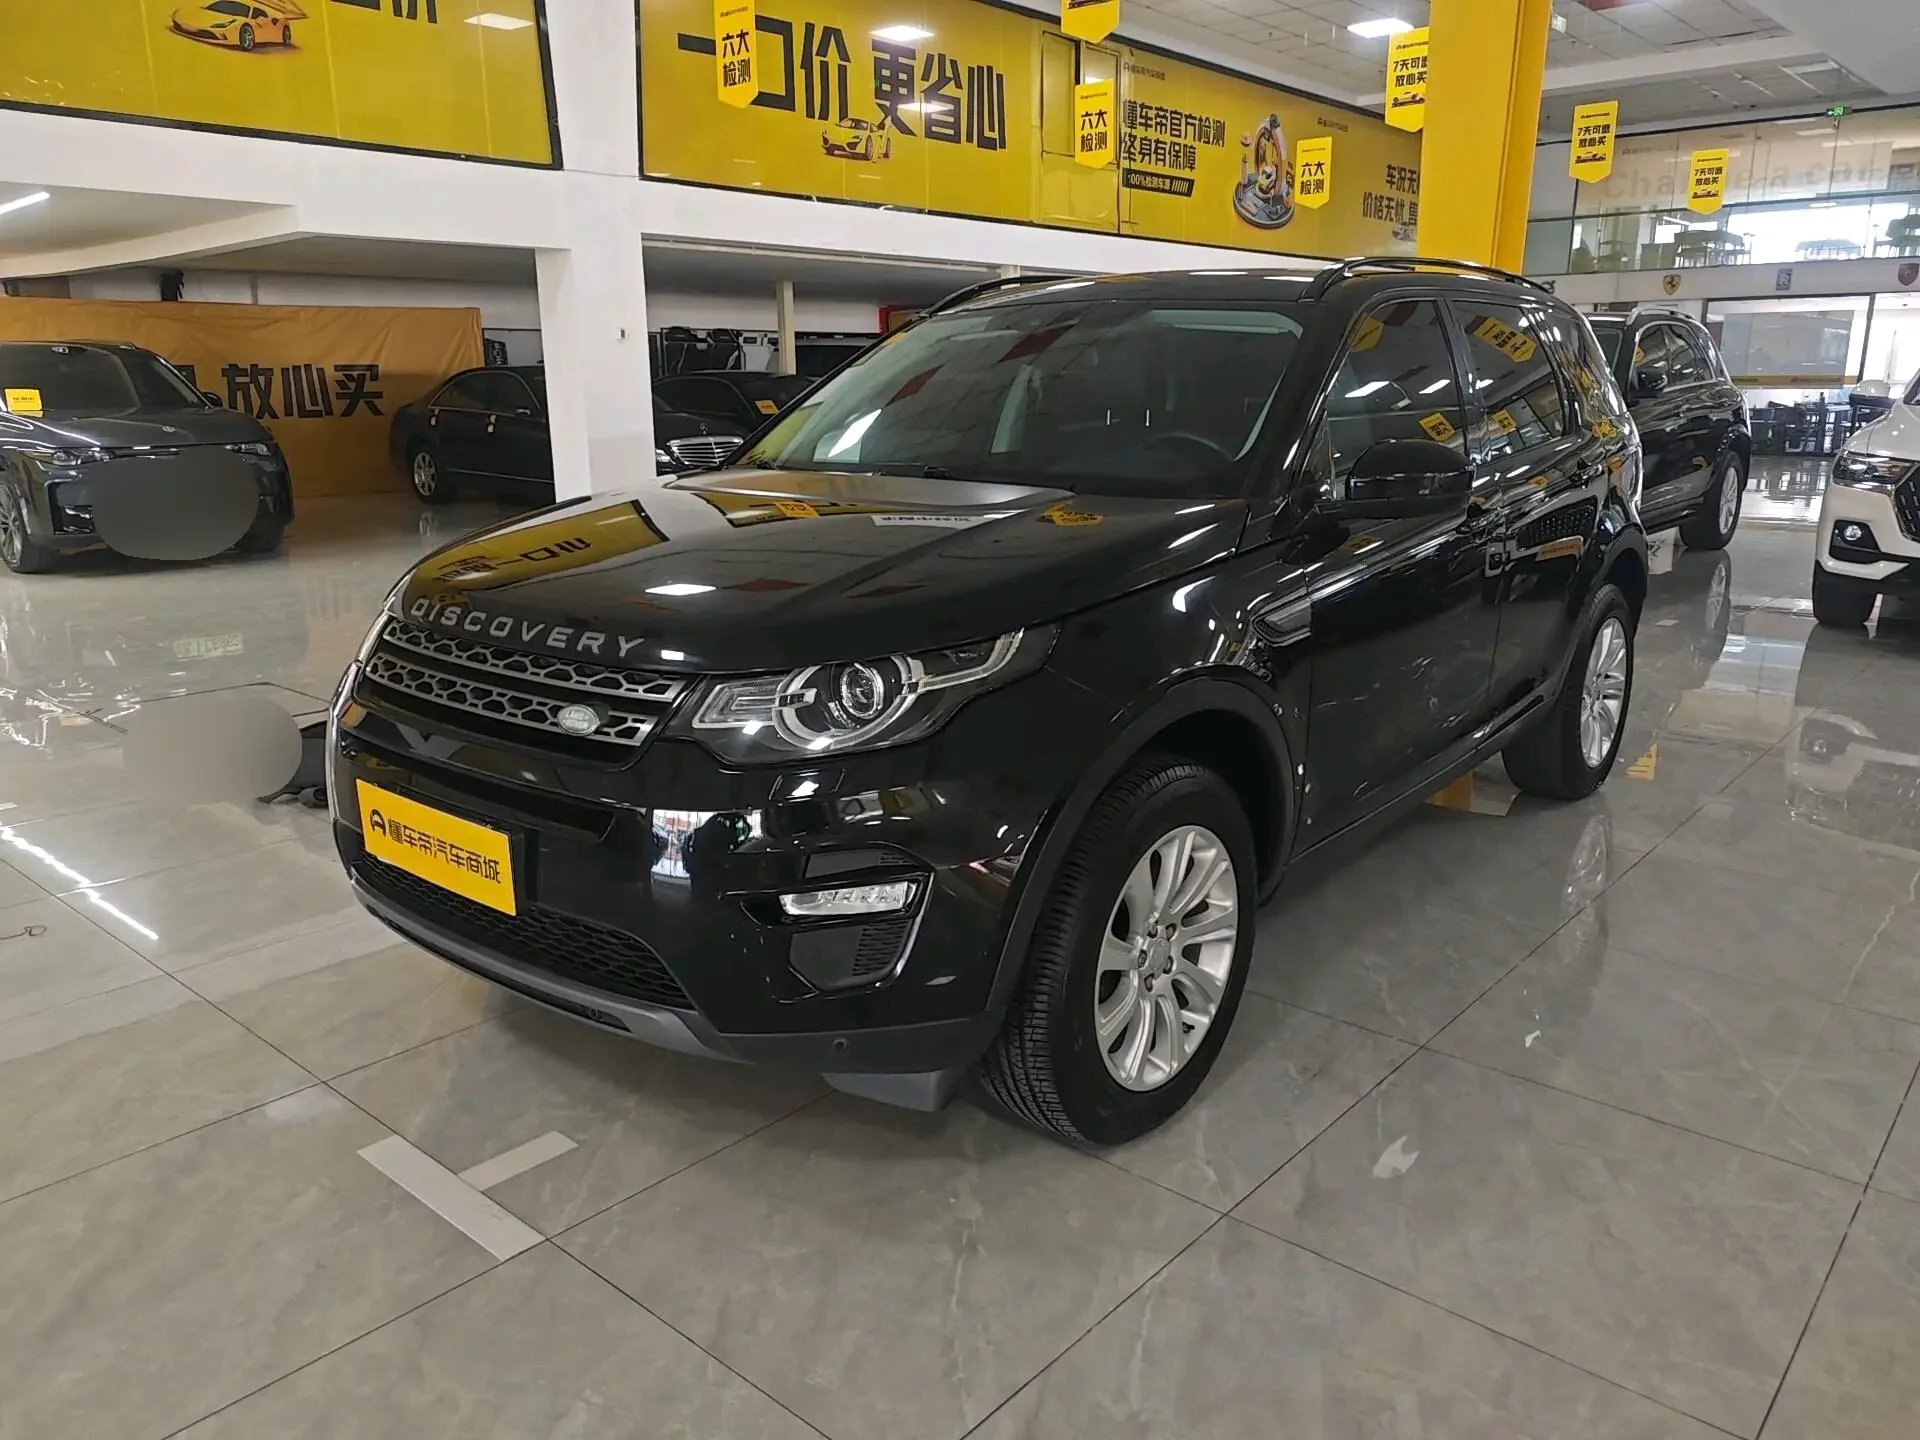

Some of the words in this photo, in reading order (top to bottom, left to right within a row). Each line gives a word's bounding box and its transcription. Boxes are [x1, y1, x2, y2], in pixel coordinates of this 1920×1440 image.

[722, 29, 749, 58] 六大
[723, 57, 751, 87] 检测
[1395, 71, 1428, 88] 放心买
[871, 39, 1007, 152] 更省心
[1081, 109, 1108, 131] 六大
[1081, 130, 1108, 152] 检测
[1301, 161, 1325, 177] 六大
[1300, 178, 1325, 195] 检测
[221, 363, 384, 420] 放心买
[410, 597, 645, 657] DISCOVERY
[388, 818, 501, 884] 懂车帝汽车商城
